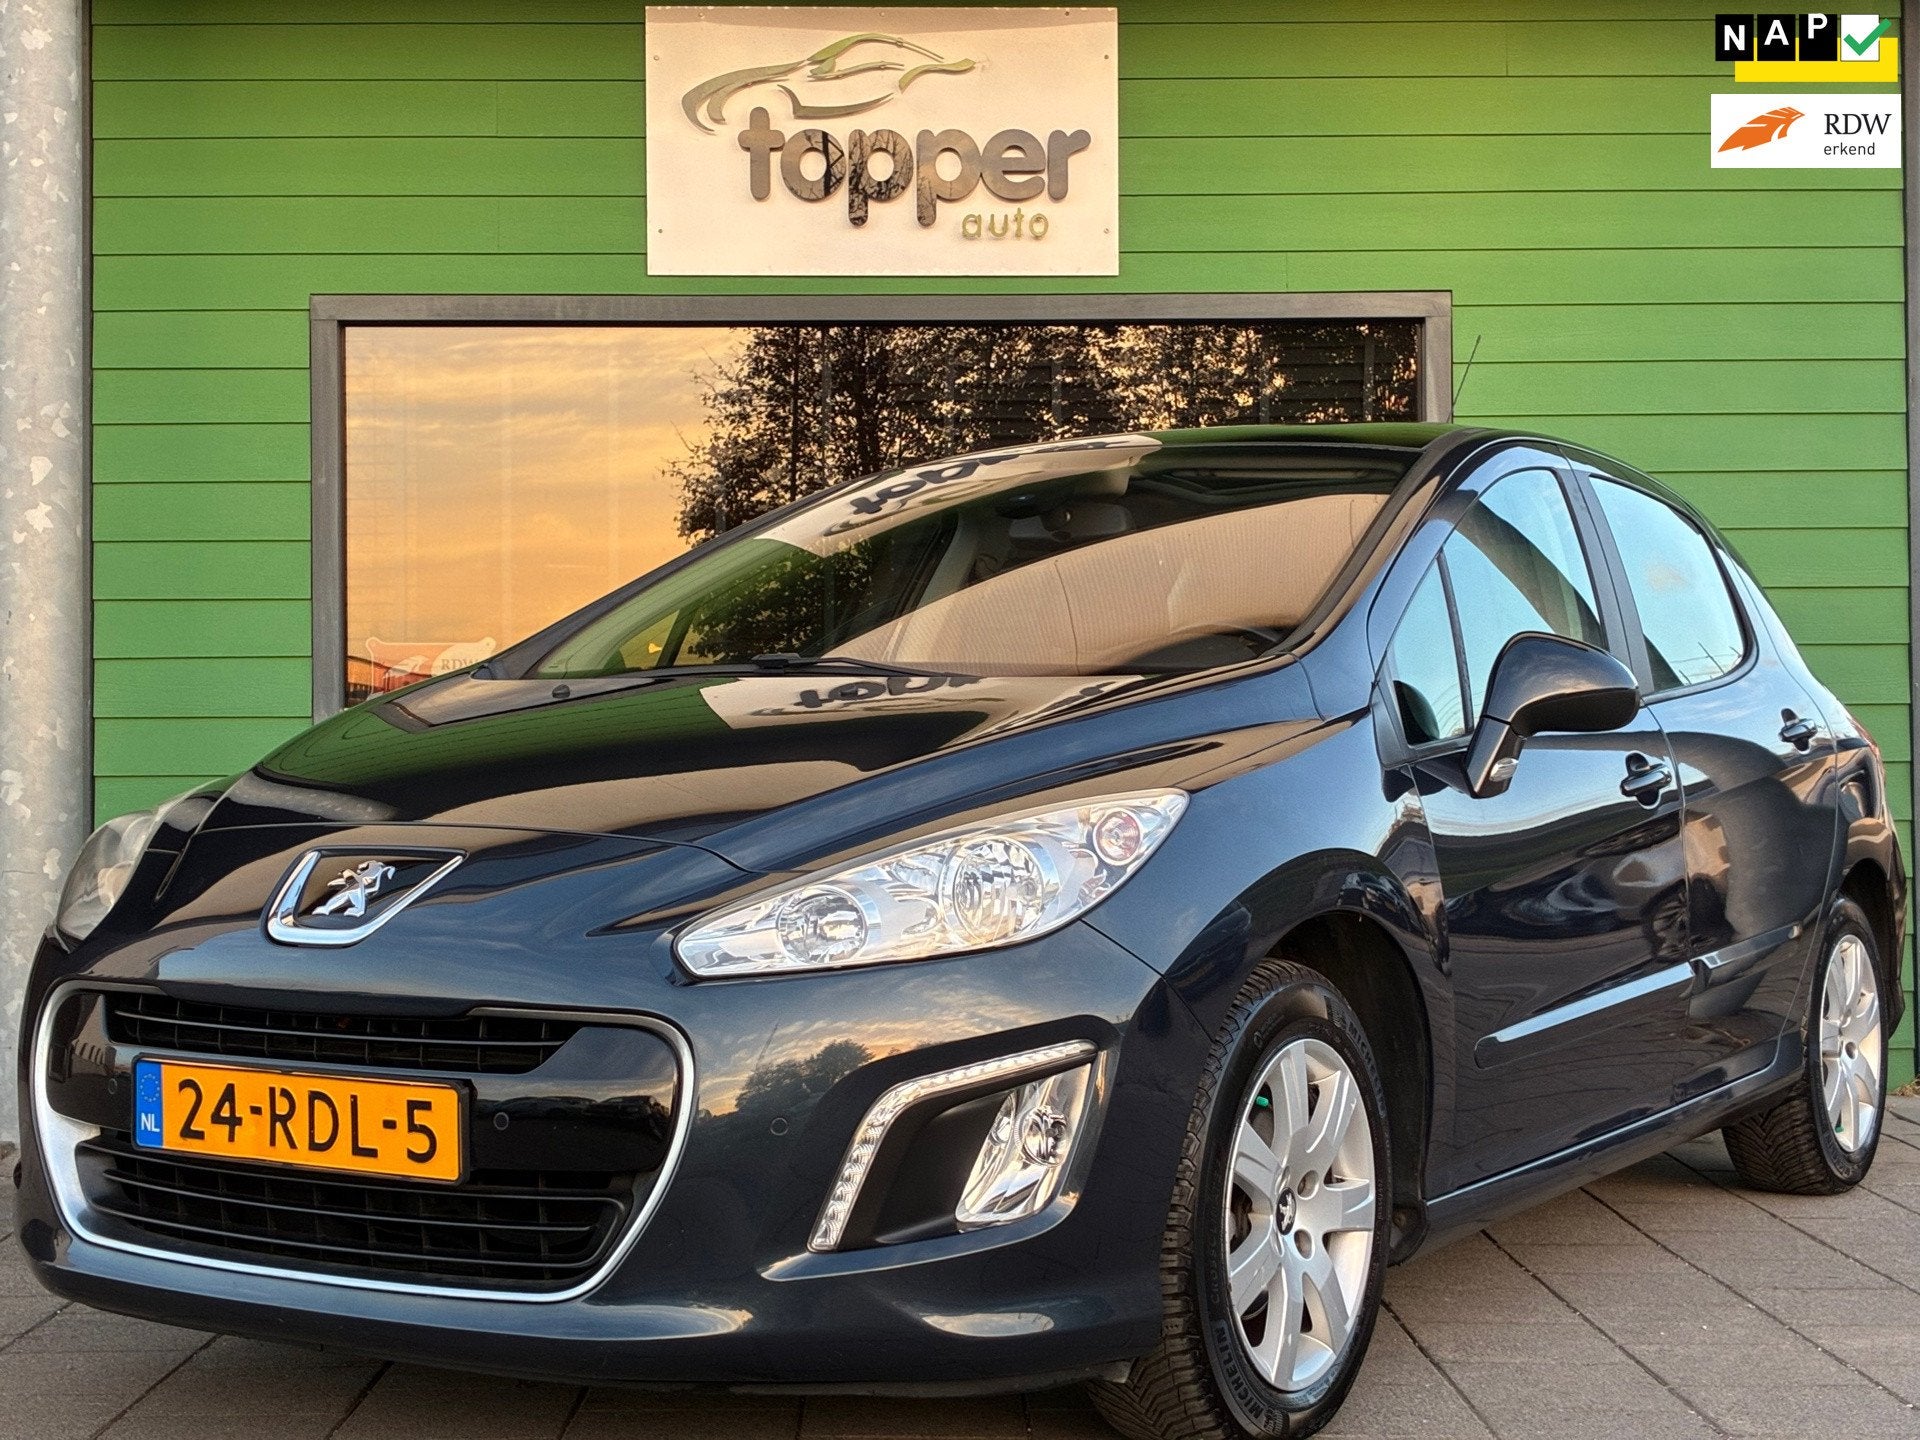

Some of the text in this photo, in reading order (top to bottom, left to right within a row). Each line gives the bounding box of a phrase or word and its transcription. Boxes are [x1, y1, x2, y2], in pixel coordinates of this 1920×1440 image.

[737, 106, 1092, 227] topper
[961, 207, 1050, 239] auto
[140, 1112, 160, 1133] NL
[178, 1078, 438, 1164] 24-RDL-5
[1214, 1326, 1265, 1419] MICHELIN
